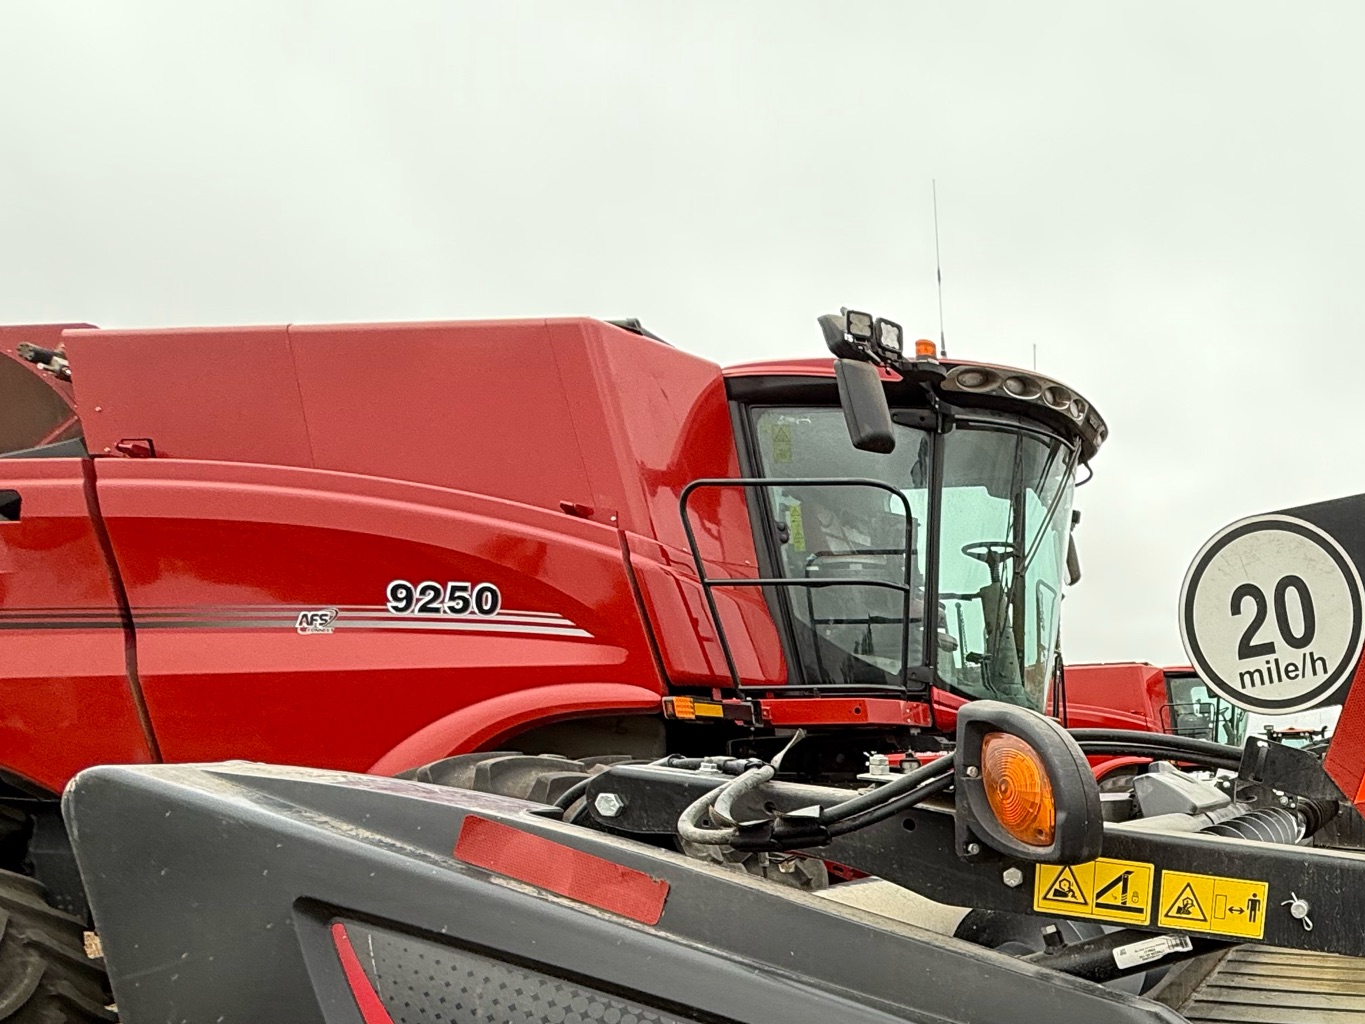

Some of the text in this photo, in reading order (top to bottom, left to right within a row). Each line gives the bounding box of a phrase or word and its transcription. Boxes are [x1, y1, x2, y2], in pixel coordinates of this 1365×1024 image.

[387, 580, 501, 617] 9250
[1230, 574, 1316, 661] 20
[298, 612, 330, 627] AFS
[1238, 651, 1328, 690] mile/h
